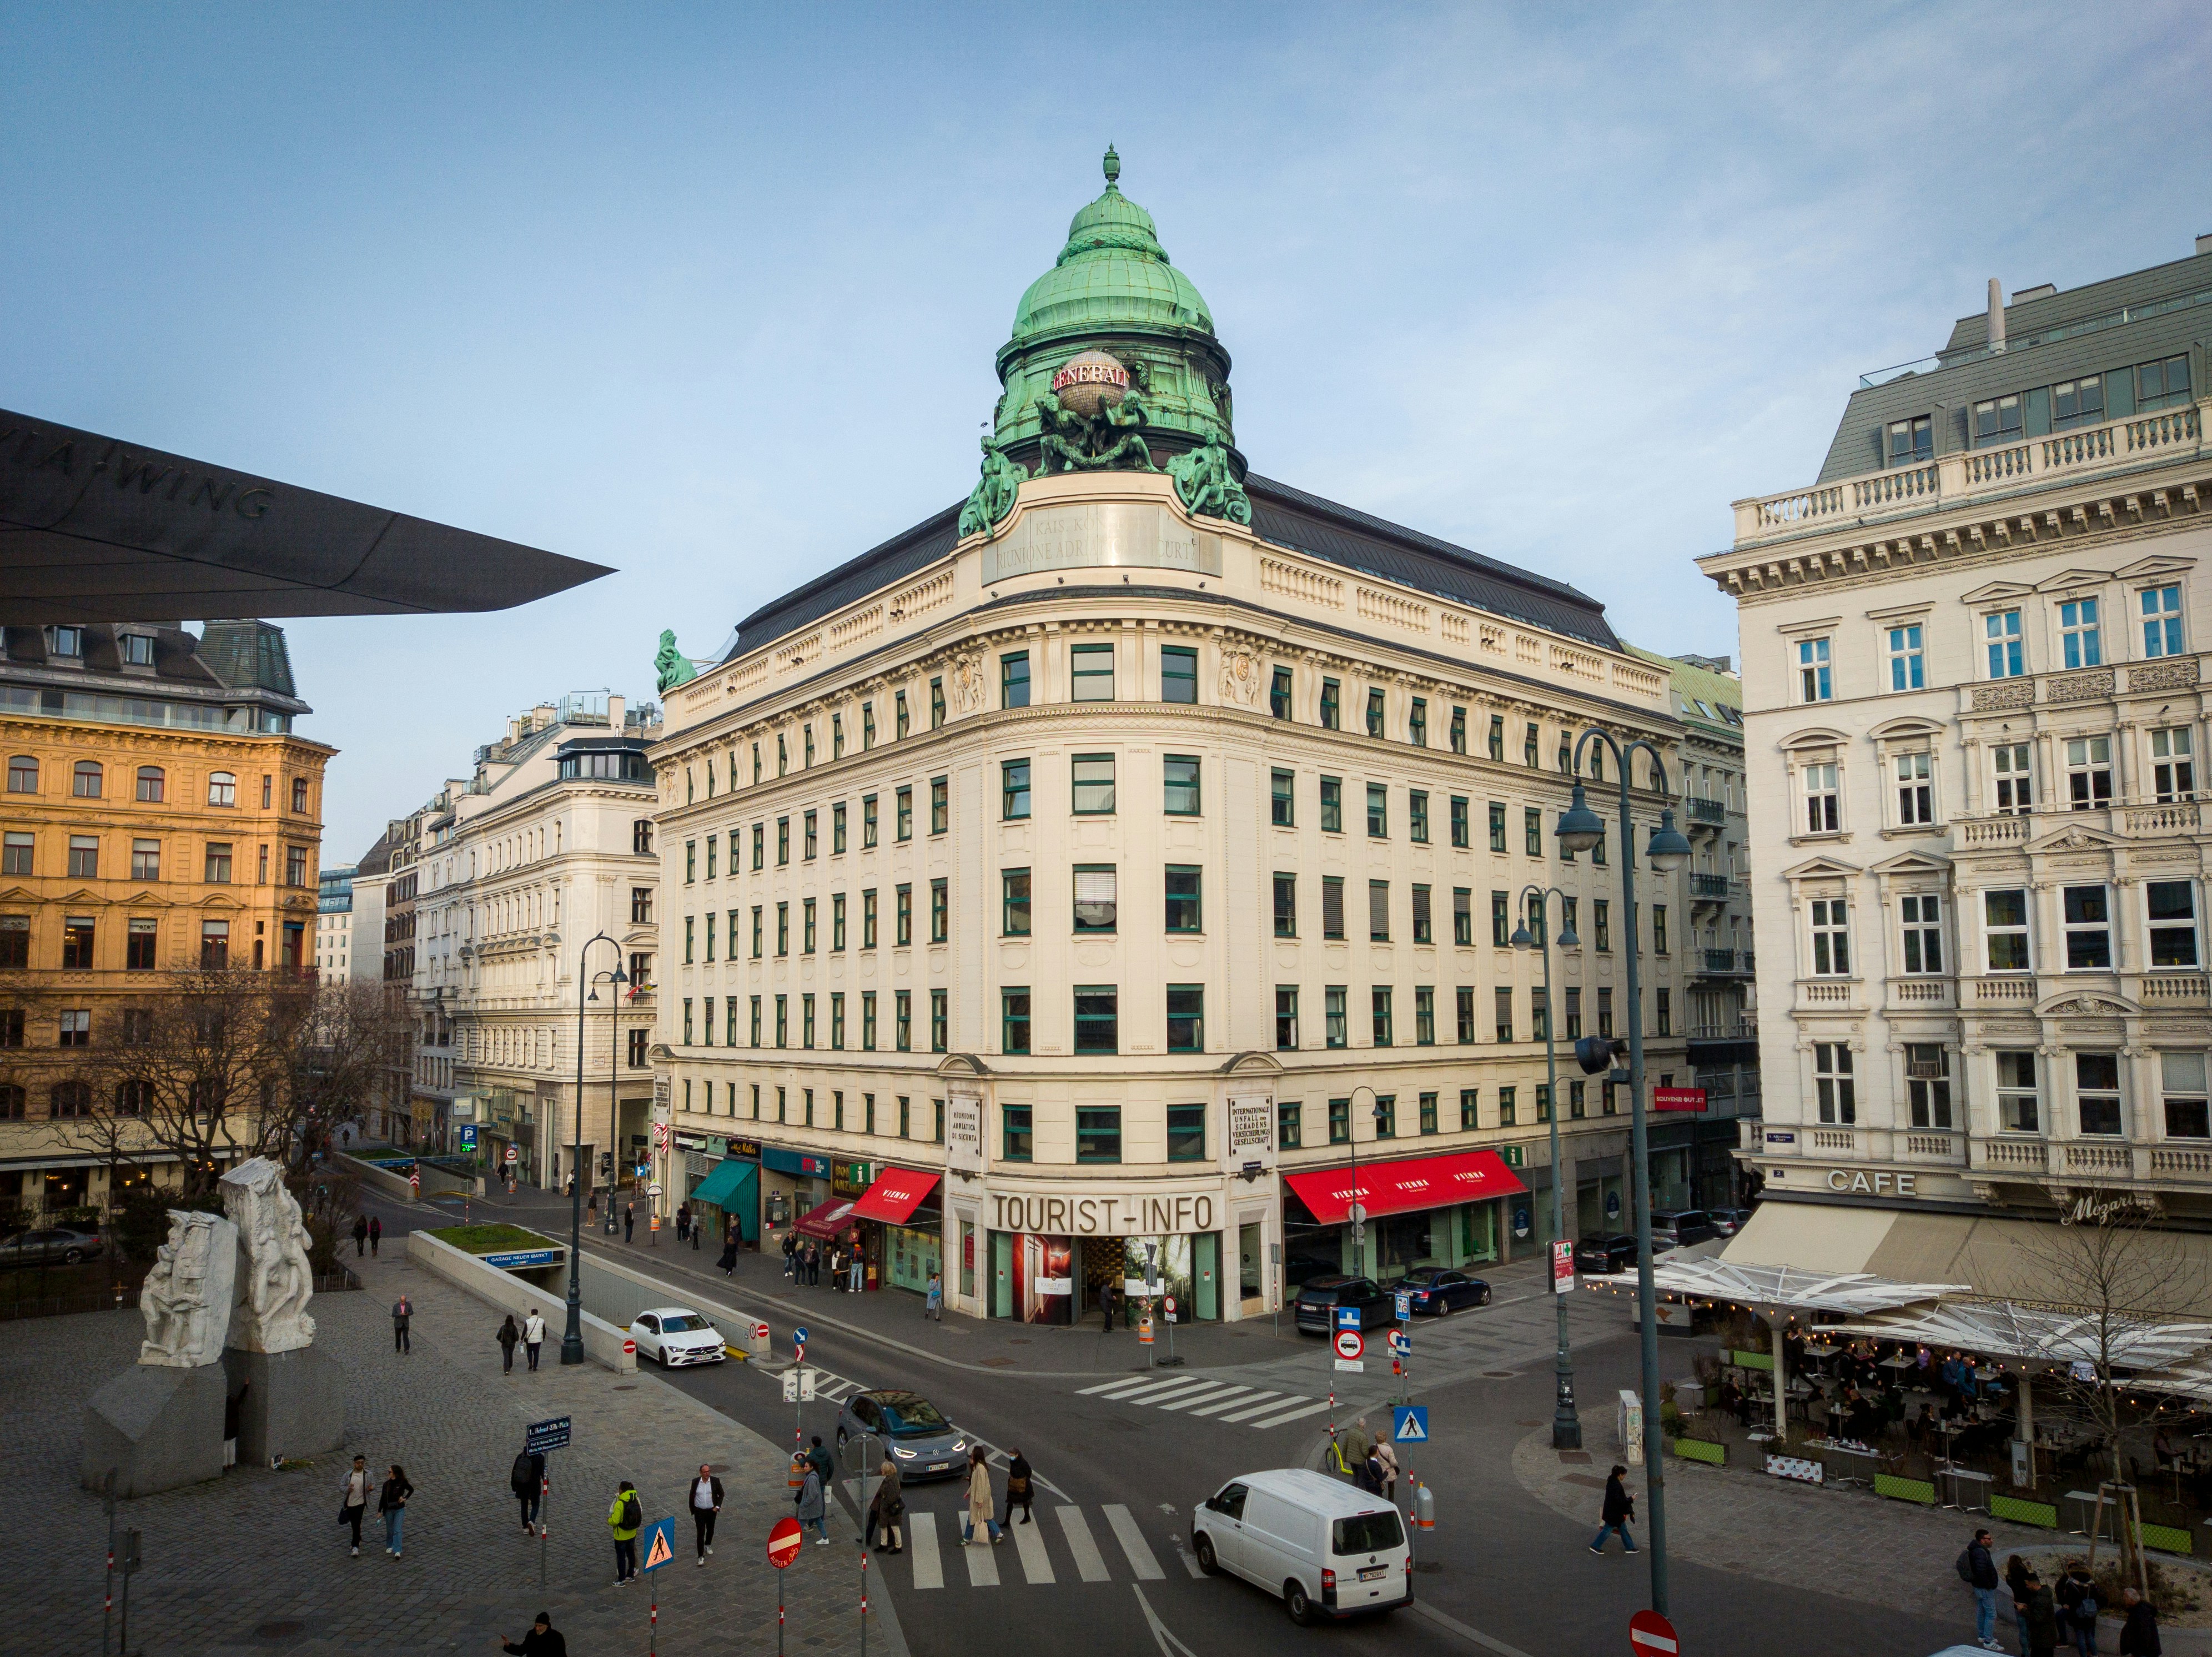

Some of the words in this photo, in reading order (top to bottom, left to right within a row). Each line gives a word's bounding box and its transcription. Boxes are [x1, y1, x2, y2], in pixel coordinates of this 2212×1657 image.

[1054, 365, 1126, 390] GENERALI
[117, 455, 275, 519] WING
[1035, 519, 1068, 536] KAIS.
[998, 542, 1052, 570] RIUNIONE
[953, 1112, 976, 1120] RIUNIONE
[1232, 1106, 1269, 1116] INTERNATIONALE
[953, 1122, 976, 1131] ADRIATICA
[1235, 1121, 1267, 1131] SCHADENS
[1232, 1128, 1270, 1138] VERSICHERUNGS
[1234, 1136, 1269, 1146] GESELLSCHAFT
[1454, 1171, 1486, 1182] VIENNA
[1395, 1178, 1430, 1190] VIENNA
[1827, 1169, 1917, 1196] CAFE
[883, 1189, 910, 1200] VIENNA
[770, 1555, 789, 1567] AUSGEN.
